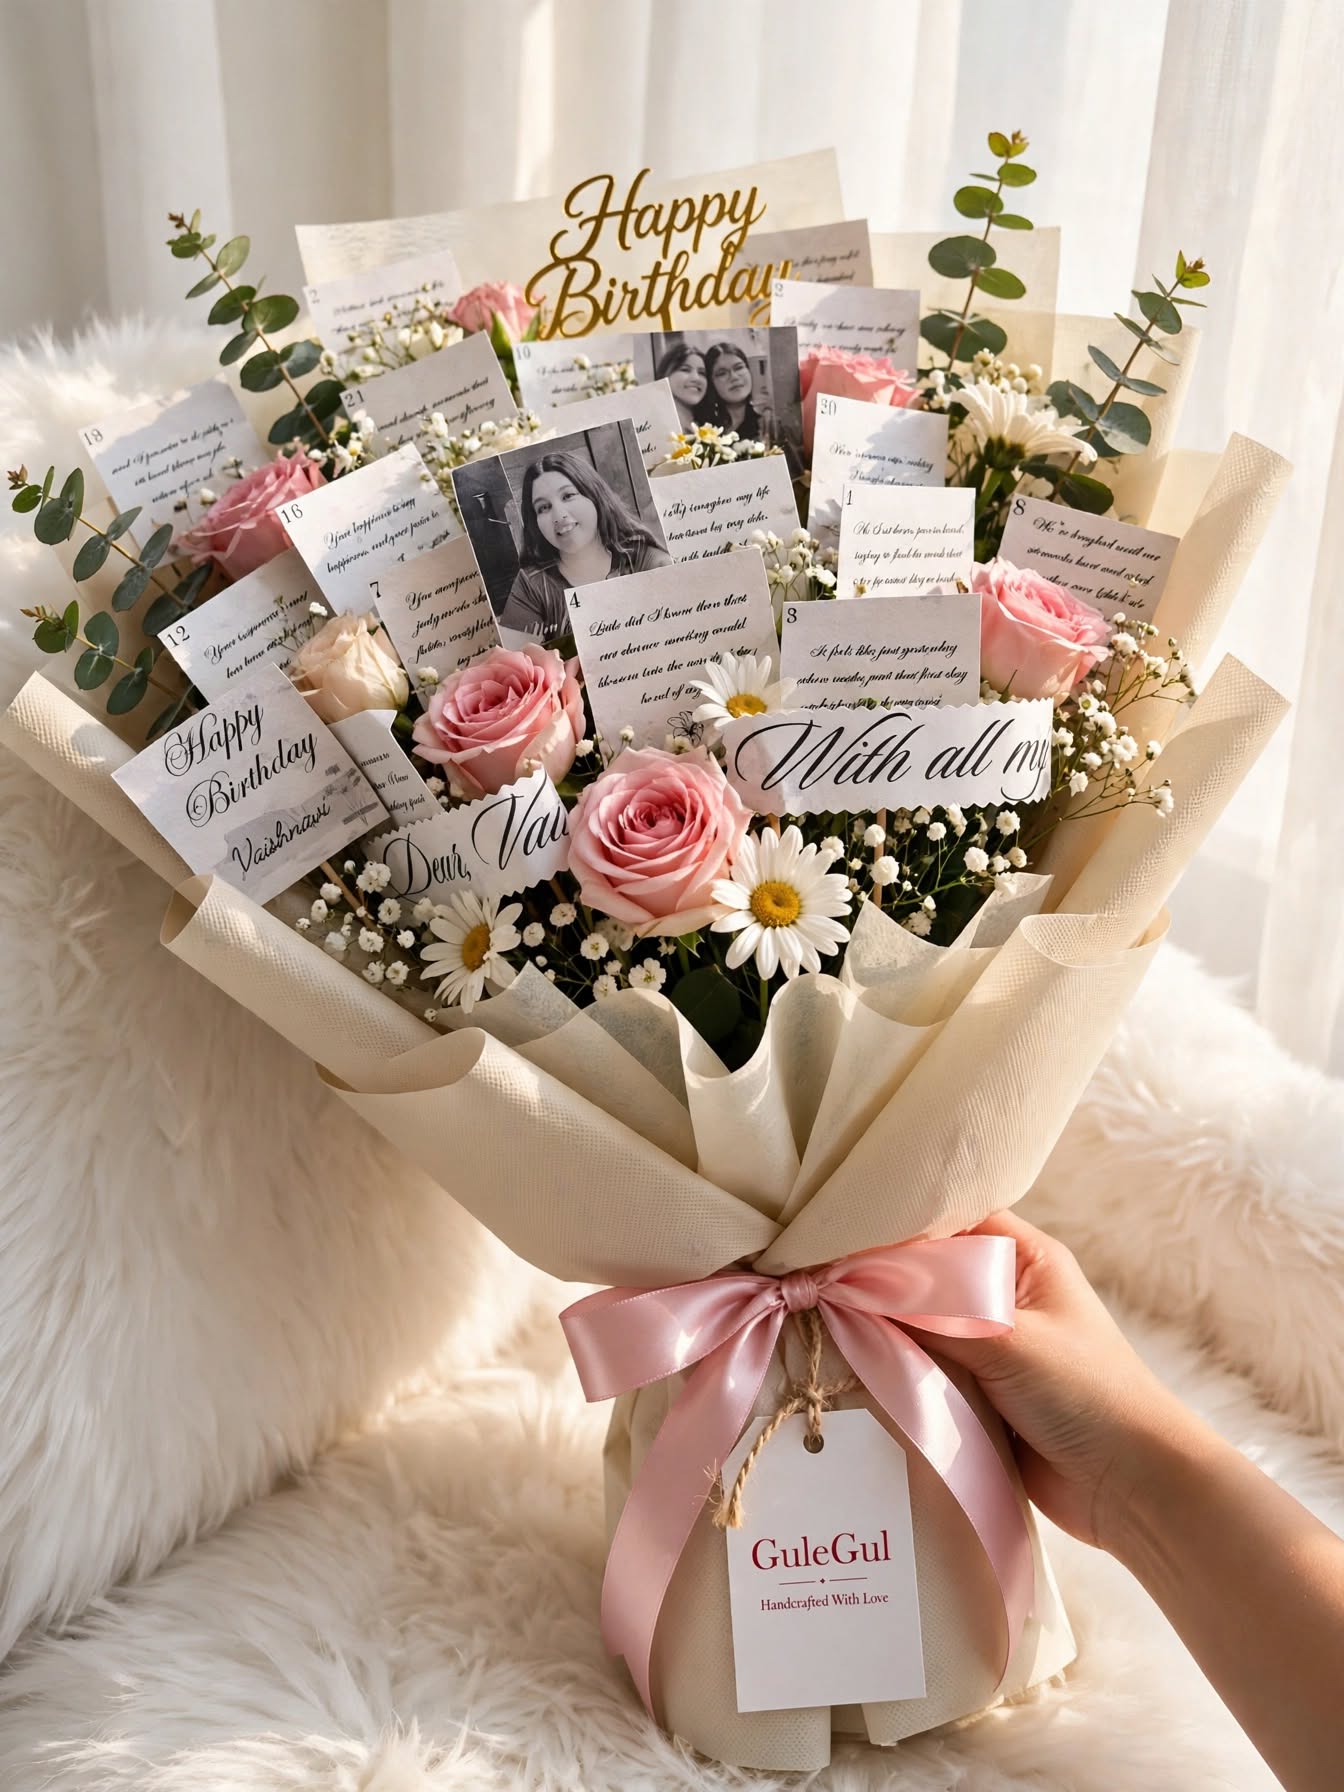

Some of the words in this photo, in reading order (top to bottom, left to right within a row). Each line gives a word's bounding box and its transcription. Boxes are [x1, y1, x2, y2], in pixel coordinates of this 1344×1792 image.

[551, 167, 766, 284] Happy
[526, 240, 799, 340] Birthday
[846, 489, 854, 506] 1
[1012, 498, 1026, 516] 8
[369, 581, 382, 599] 7
[569, 591, 581, 609] 4
[167, 624, 191, 649] 12
[163, 703, 265, 777] Happy
[735, 712, 925, 791] With
[925, 718, 1015, 780] all
[1001, 739, 1050, 801] my
[186, 732, 318, 828] Birthday
[232, 797, 331, 874] Vaishnavi
[751, 1530, 891, 1570] GuleGul
[761, 1595, 829, 1611] Handcrafted
[831, 1592, 860, 1605] With
[863, 1592, 889, 1605] Love
